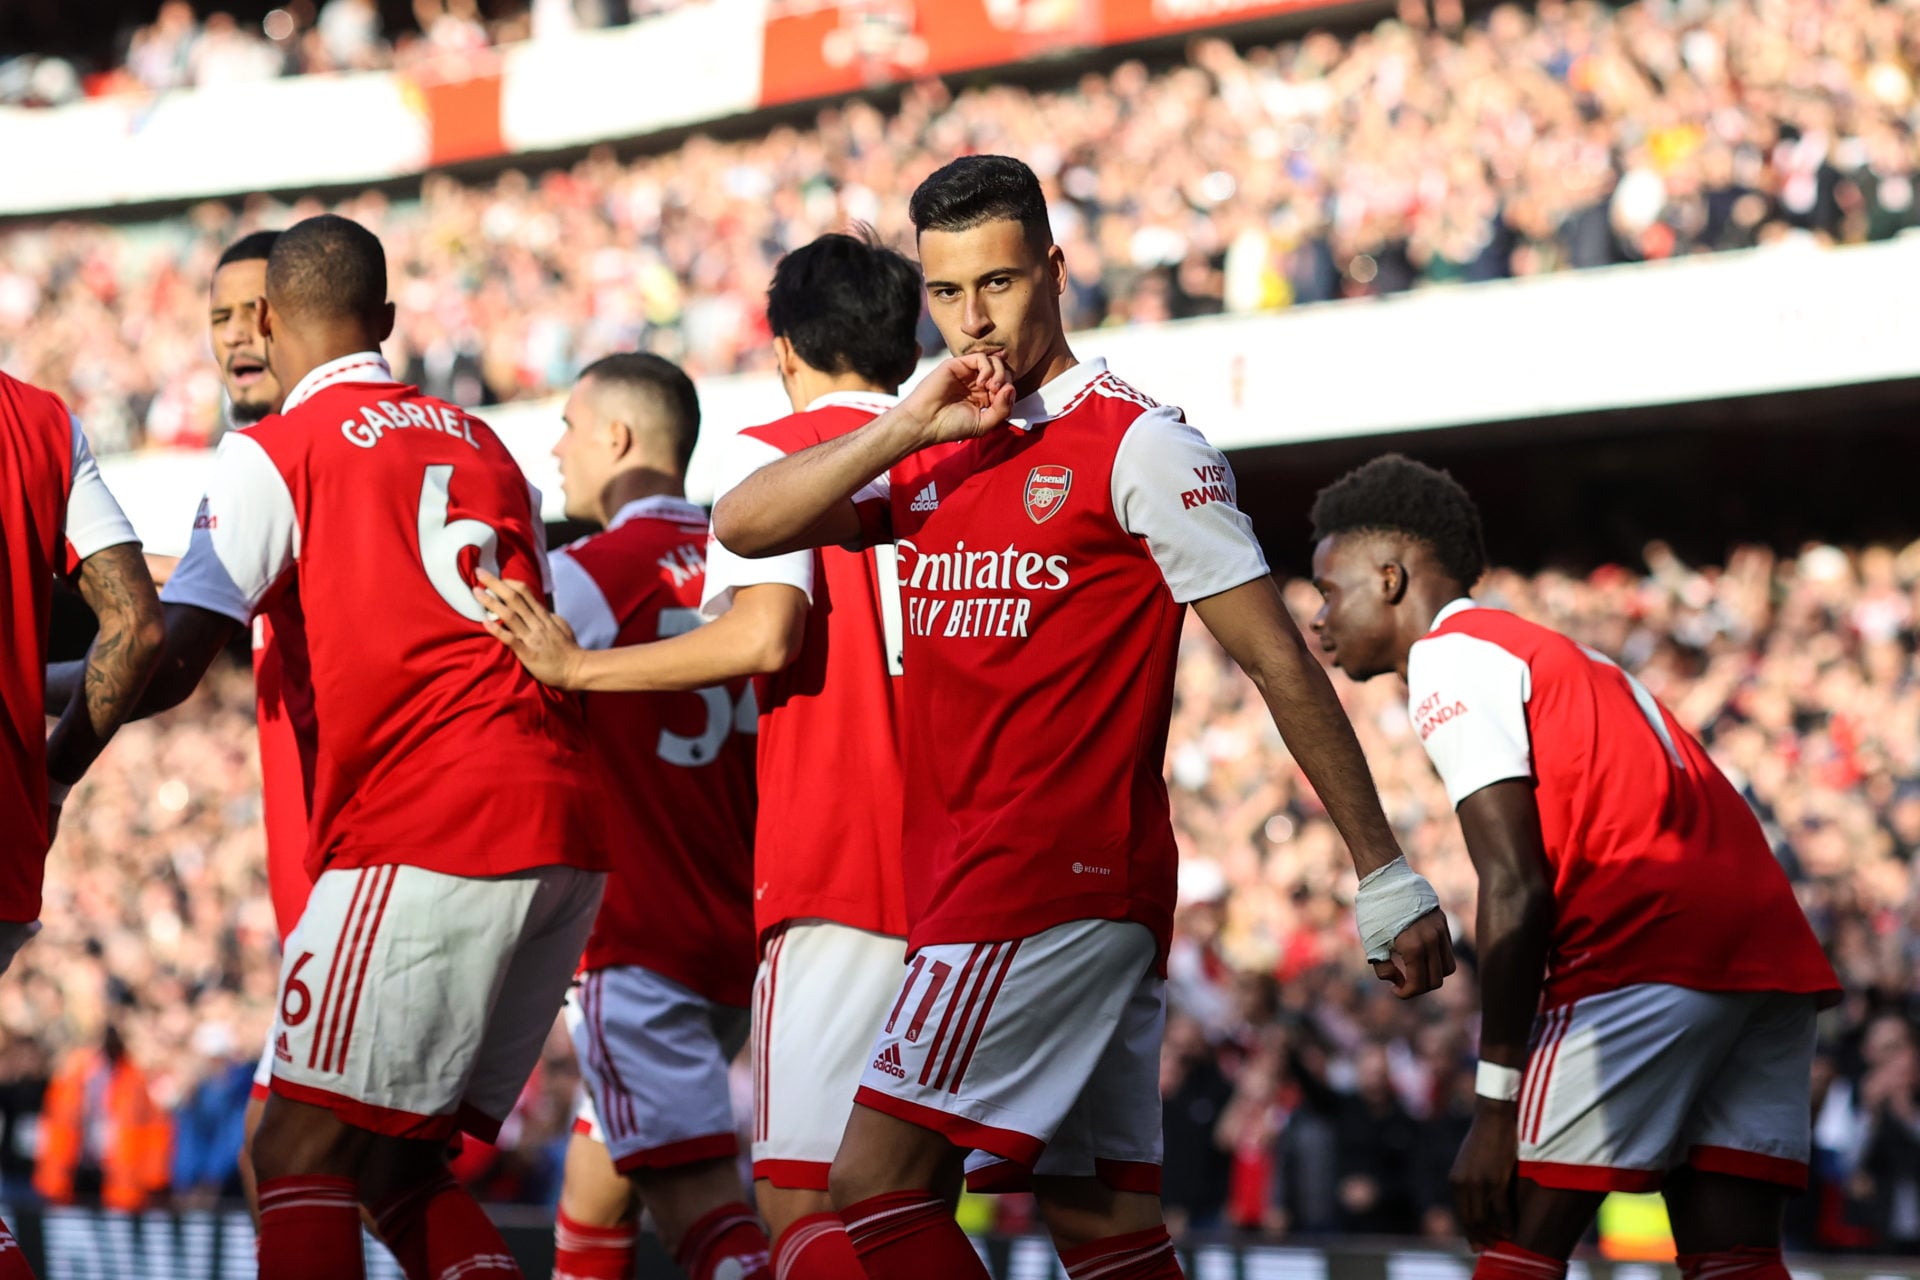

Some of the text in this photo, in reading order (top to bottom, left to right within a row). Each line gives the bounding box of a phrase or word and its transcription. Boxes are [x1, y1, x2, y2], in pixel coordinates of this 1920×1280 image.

[341, 401, 480, 449] GABRIEL
[1032, 474, 1066, 484] Arsenal
[911, 500, 939, 511] adidas
[417, 464, 500, 623] 6
[895, 539, 1069, 591] Emirates
[909, 597, 1031, 638] FLY BETTER
[281, 951, 315, 1027] 6
[885, 954, 952, 1043] 11
[873, 1059, 905, 1079] adidas
